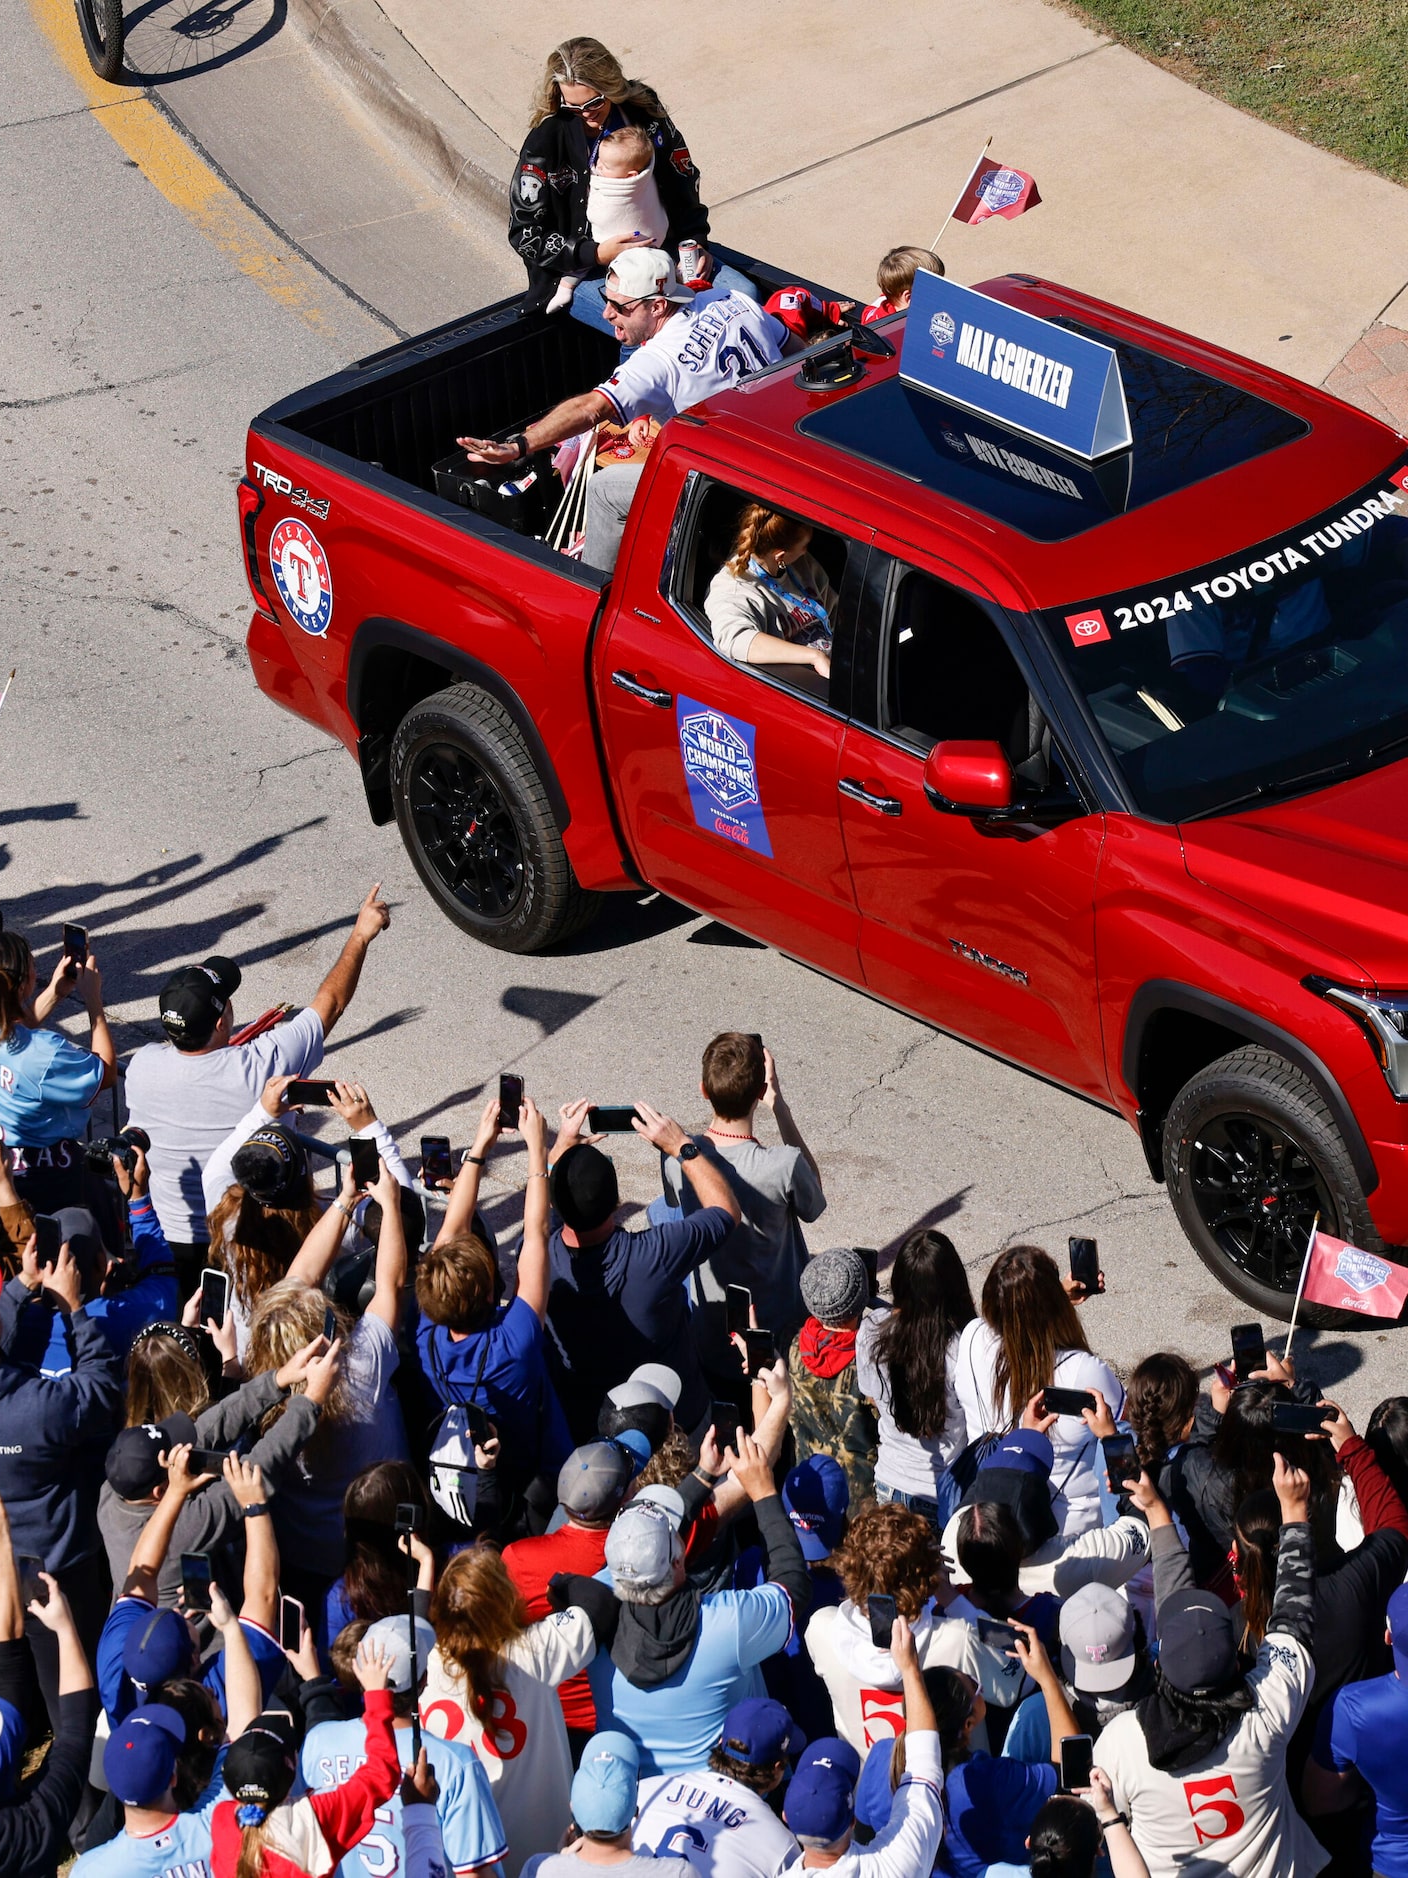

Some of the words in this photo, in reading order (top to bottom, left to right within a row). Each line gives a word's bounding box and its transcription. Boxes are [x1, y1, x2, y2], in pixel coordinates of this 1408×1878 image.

[678, 290, 749, 372] SCHERZER
[956, 322, 995, 376] MAX
[991, 338, 1073, 409] SCHERZER
[253, 461, 293, 494] TRD
[277, 526, 324, 566] TEXAS
[1113, 589, 1193, 630] 2024
[1191, 546, 1311, 607] TOYOTA
[1300, 489, 1404, 558] TUNDRA
[275, 571, 329, 628] RANGERS
[289, 551, 313, 605] T
[698, 733, 735, 762] WORLD
[708, 713, 723, 740] T
[687, 746, 752, 789] CHAMPIONS
[715, 818, 749, 845] Coca-Cola
[948, 938, 1028, 986] TUNDRA
[1339, 1259, 1387, 1282] CHAMPIONS
[1352, 1252, 1379, 1267] WORLD
[1085, 1644, 1109, 1662] T
[860, 1687, 908, 1749] 5
[667, 1784, 748, 1831] JUNG
[1184, 1774, 1246, 1845] 5
